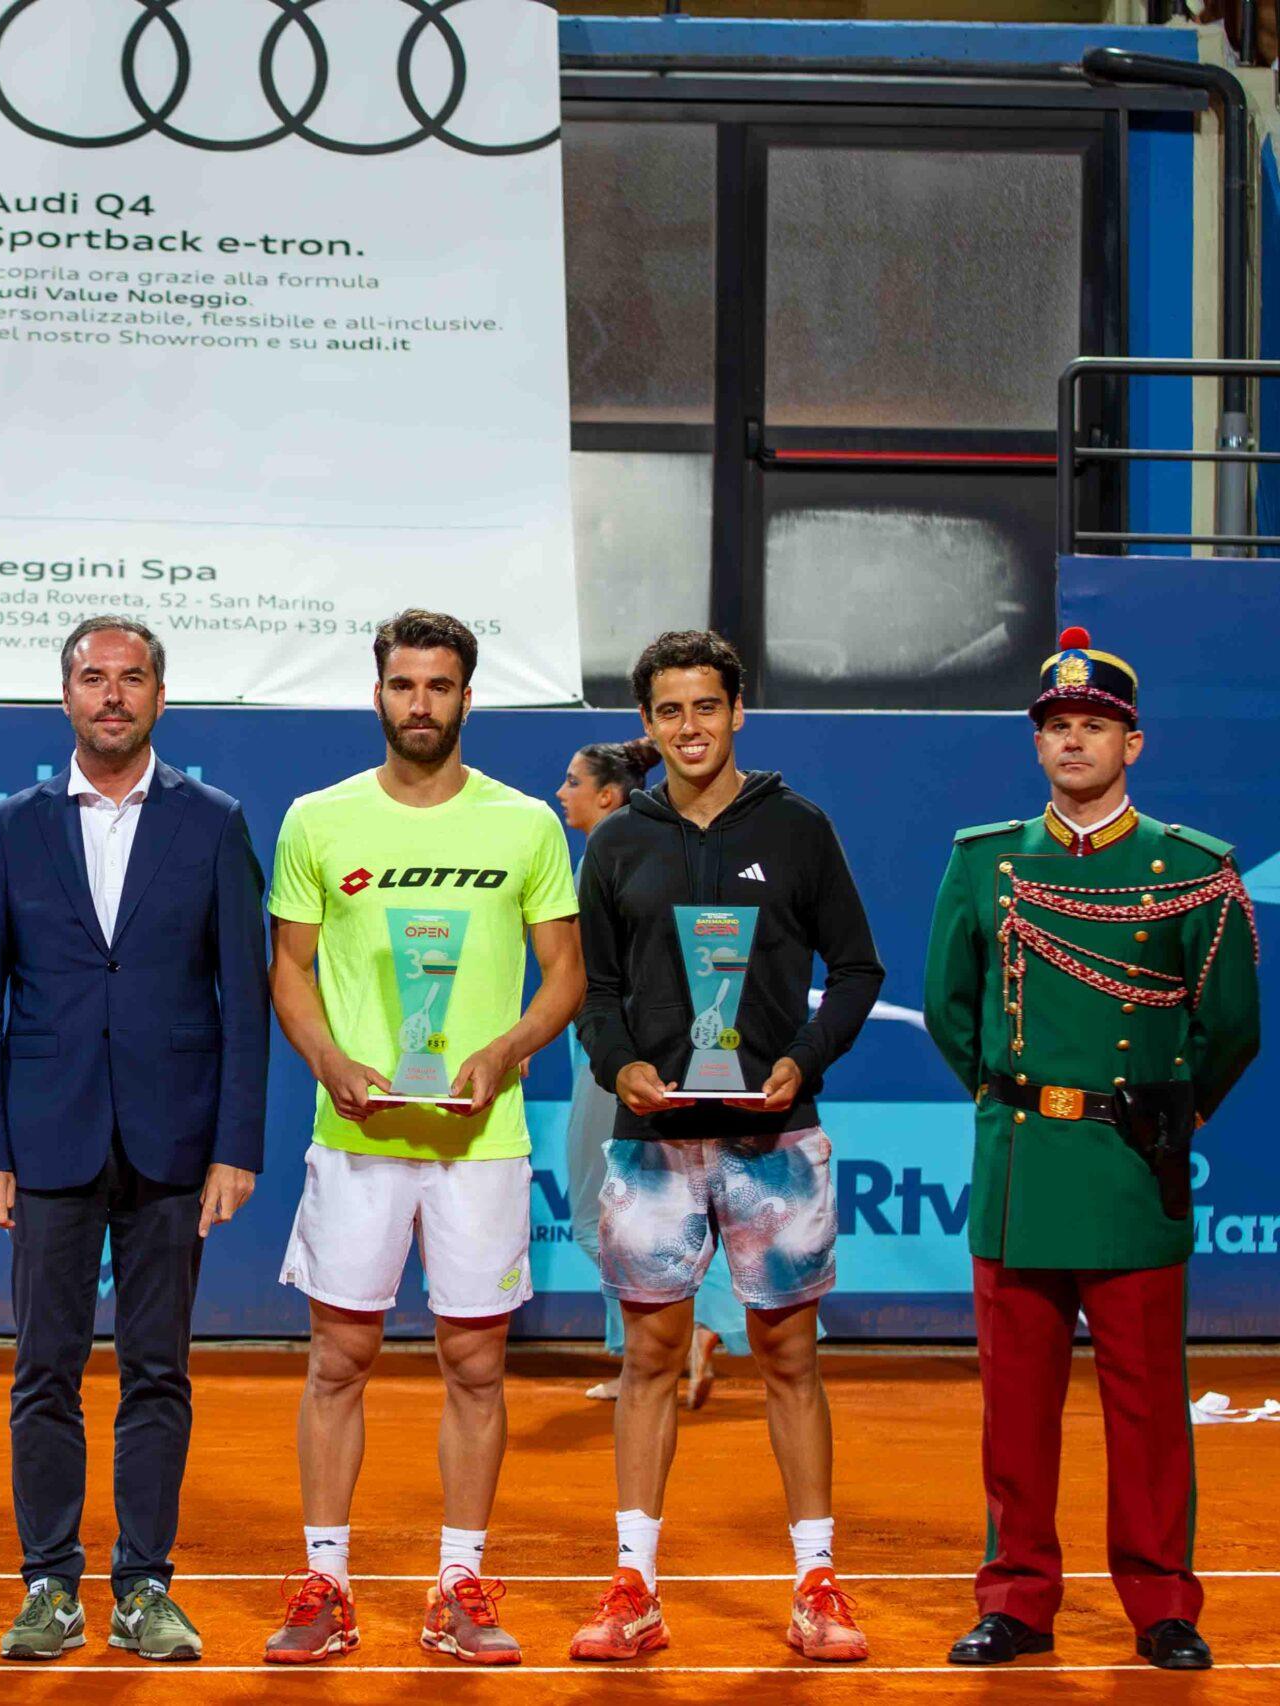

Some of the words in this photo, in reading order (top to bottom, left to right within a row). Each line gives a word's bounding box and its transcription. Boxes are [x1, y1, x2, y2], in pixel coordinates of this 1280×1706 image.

[95, 193, 156, 219] Q4
[217, 231, 365, 256] e-tron.
[89, 270, 129, 284] ora
[138, 269, 215, 287] grazie
[223, 271, 269, 287] alla
[278, 271, 380, 289] formula
[45, 287, 120, 303] Value
[201, 311, 316, 330] flessibile
[323, 319, 338, 330] e
[345, 315, 504, 332] all-inclusive.
[27, 328, 111, 344] nostro
[119, 329, 259, 348] Showroom
[267, 337, 281, 349] e
[289, 337, 318, 350] su
[326, 335, 412, 352] audi.it
[141, 558, 218, 585] Spa
[46, 588, 152, 609] Rovereta,
[159, 592, 188, 608] 52
[209, 593, 251, 609] San
[257, 594, 336, 613] Marino
[168, 614, 288, 634] WhatsApp
[293, 617, 338, 635] +39
[377, 867, 509, 889] LOTTO
[404, 926, 450, 939] OPEN
